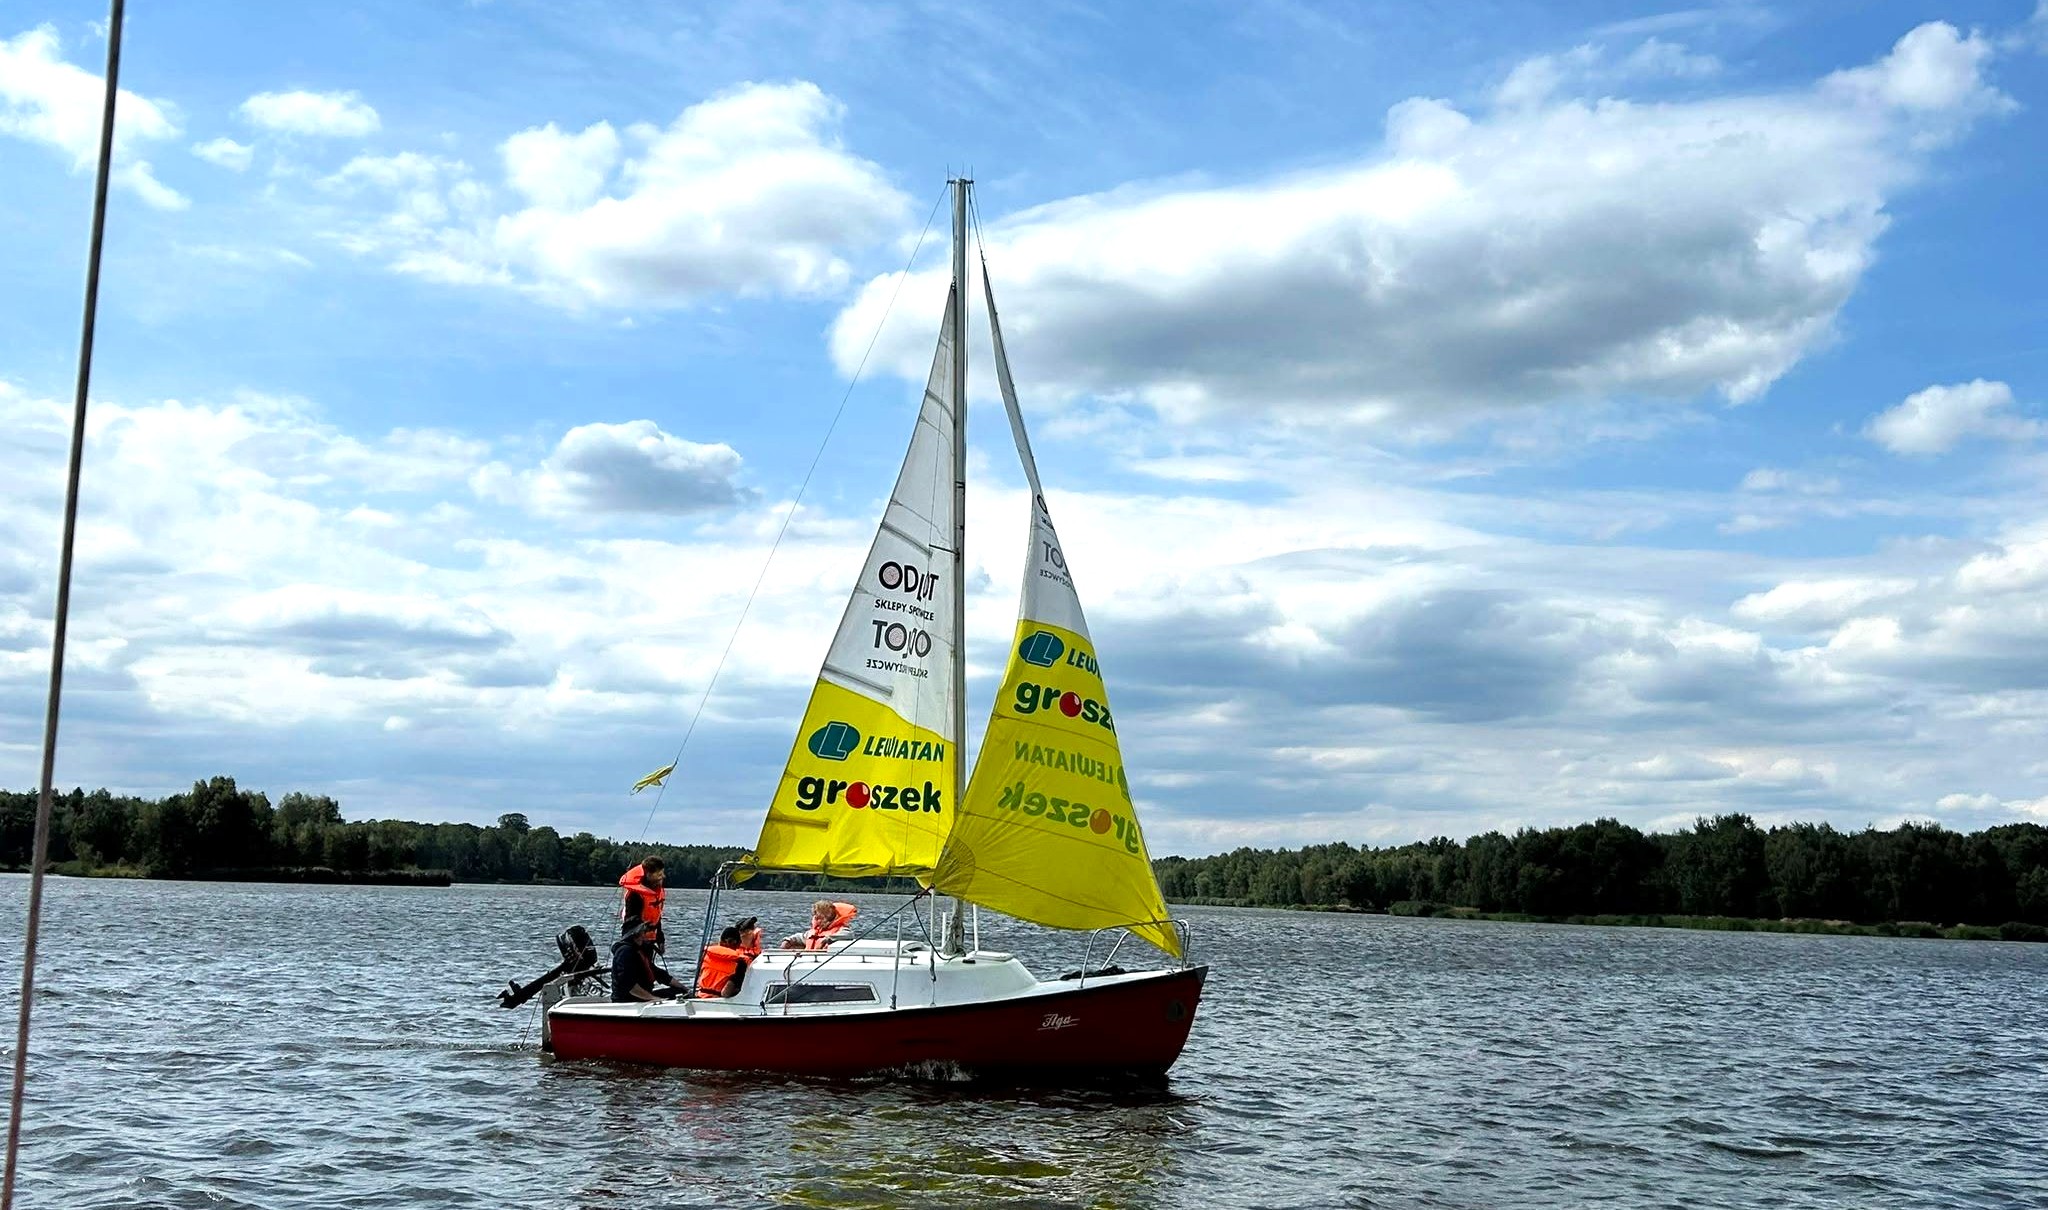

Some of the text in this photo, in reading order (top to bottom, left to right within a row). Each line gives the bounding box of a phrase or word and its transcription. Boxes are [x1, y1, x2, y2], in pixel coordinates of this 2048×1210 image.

[875, 599, 907, 612] SKLEPY
[863, 734, 945, 763] LEWIATAN
[795, 775, 942, 814] groszek
